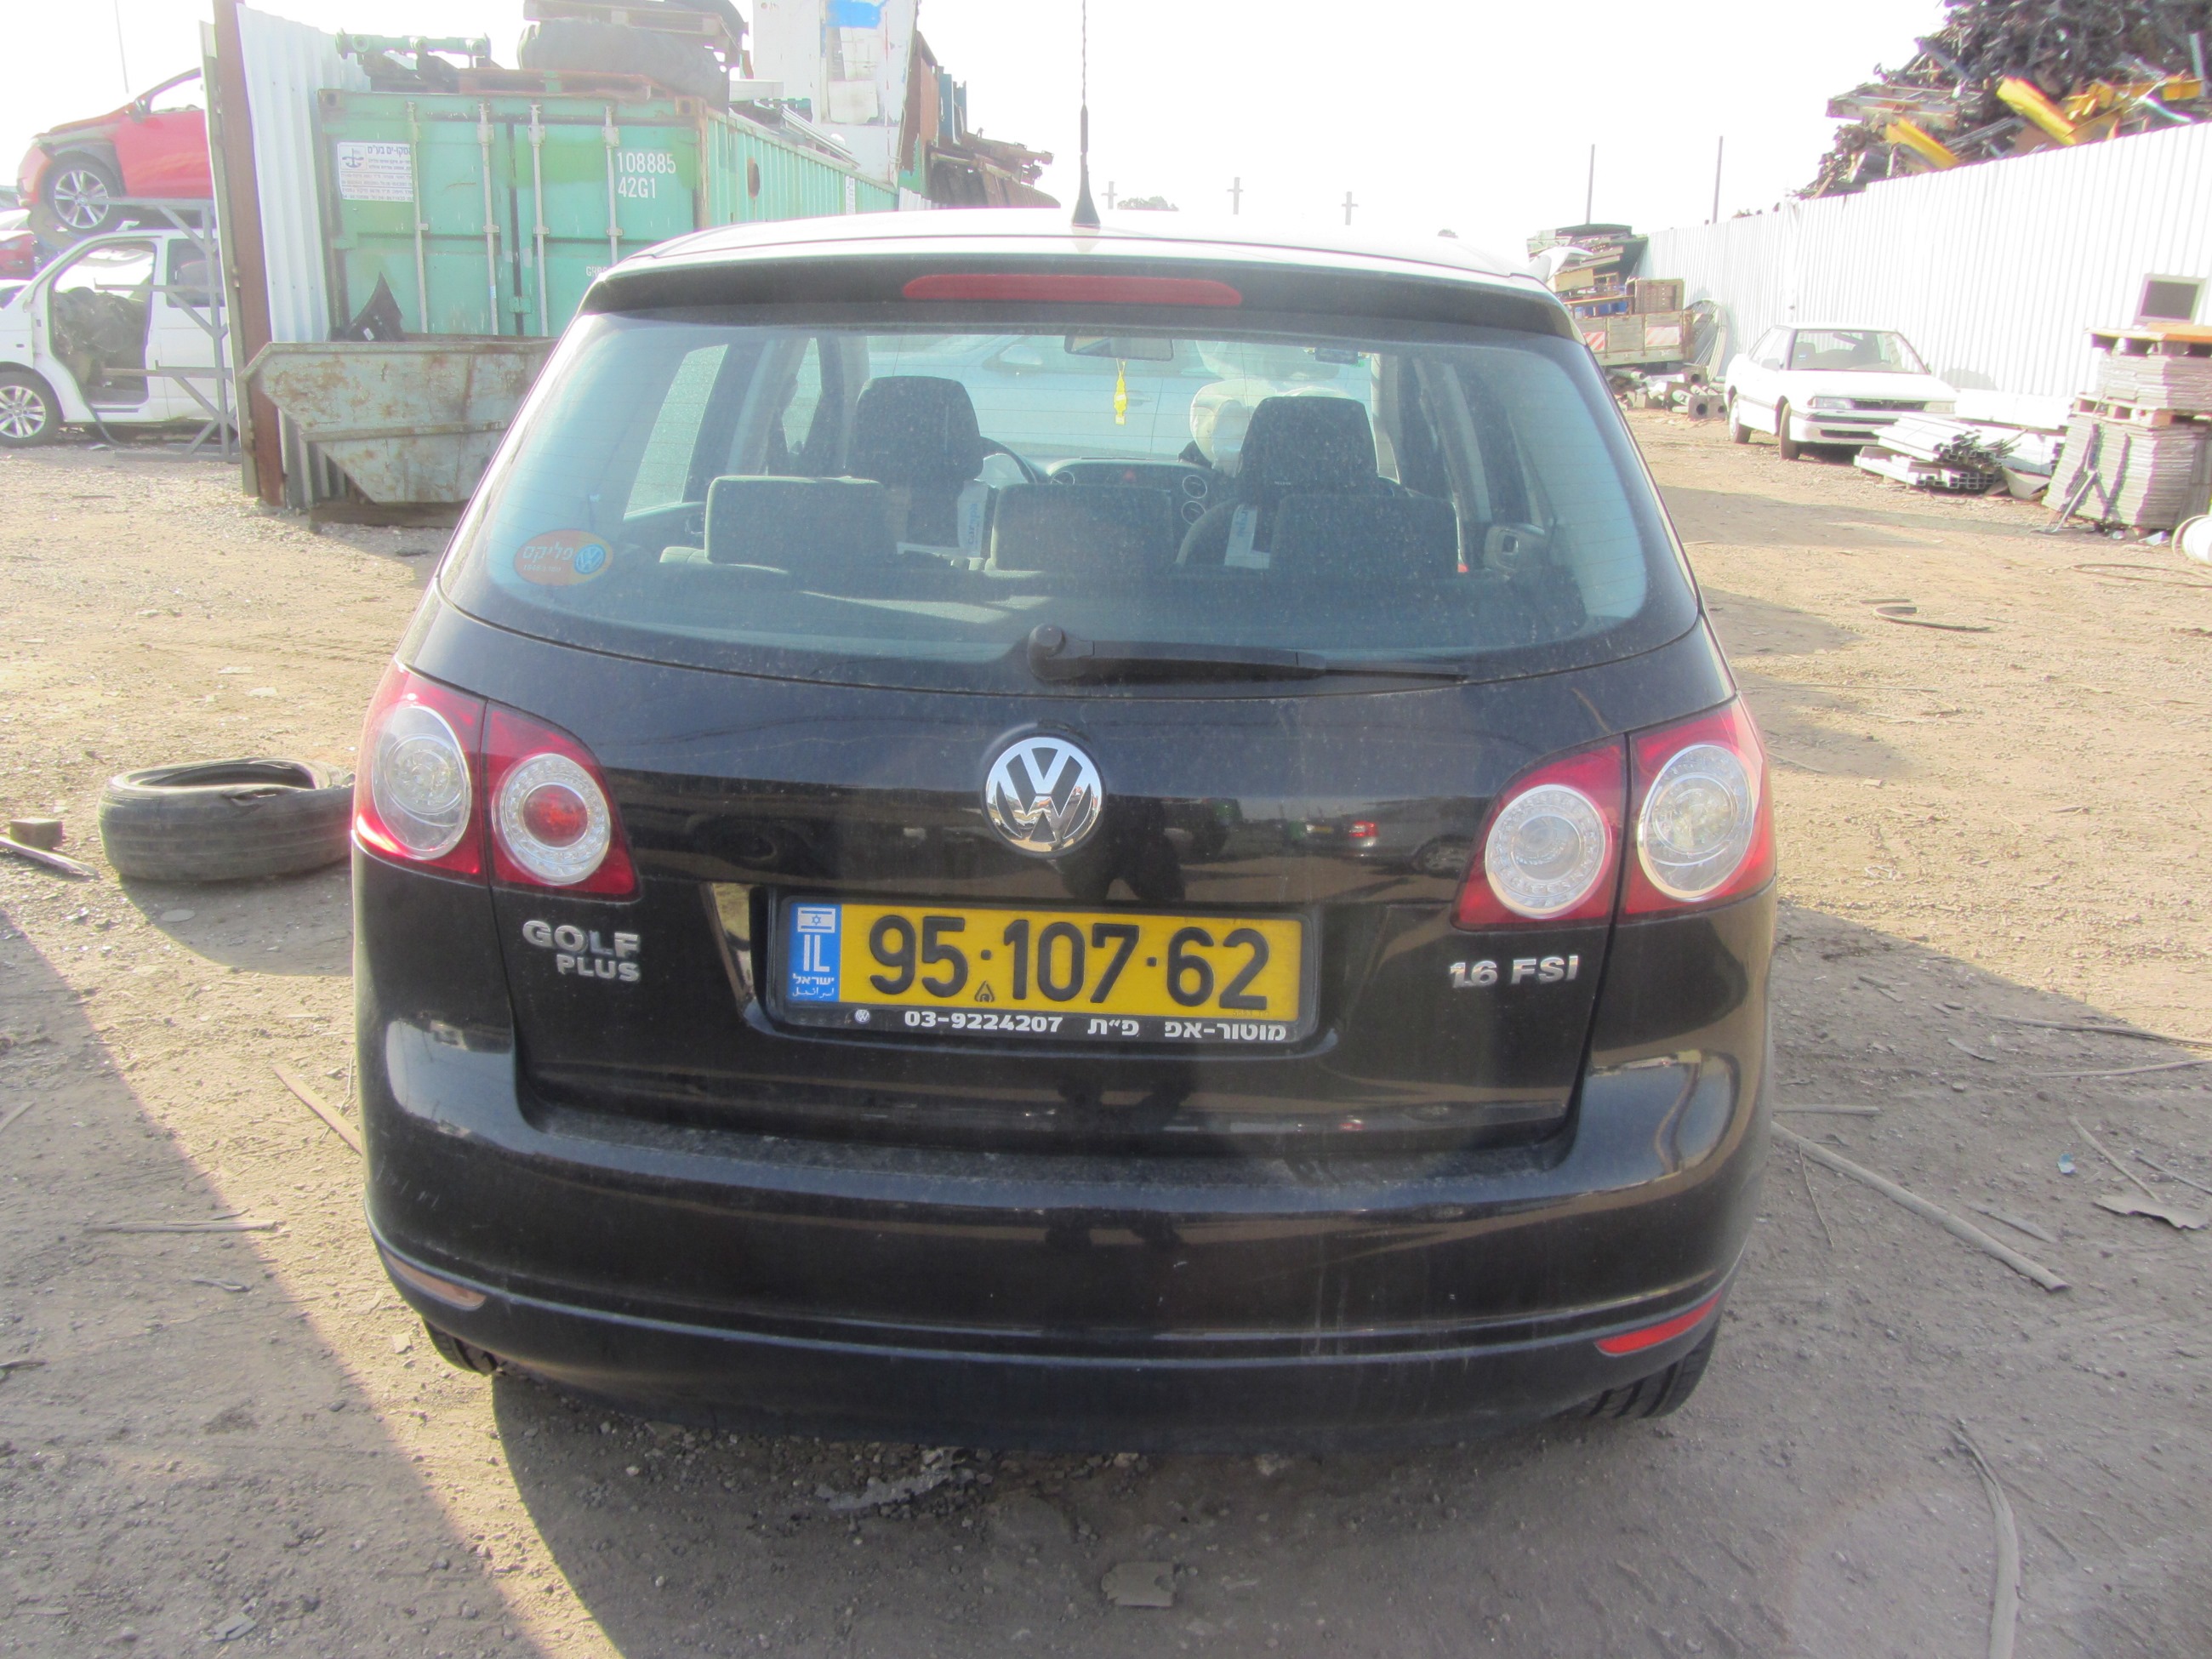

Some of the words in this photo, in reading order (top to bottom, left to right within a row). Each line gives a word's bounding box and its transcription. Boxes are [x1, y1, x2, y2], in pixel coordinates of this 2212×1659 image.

[617, 151, 676, 174] 108885
[618, 176, 656, 198] 42G1
[522, 920, 641, 959] GOLF
[803, 934, 830, 972] IL
[556, 954, 641, 983] PLUS
[792, 973, 835, 985] ישראל
[1510, 955, 1578, 985] FSI
[904, 1011, 1063, 1033] 03-9224207
[1164, 1021, 1286, 1041] מוטור-אפ
